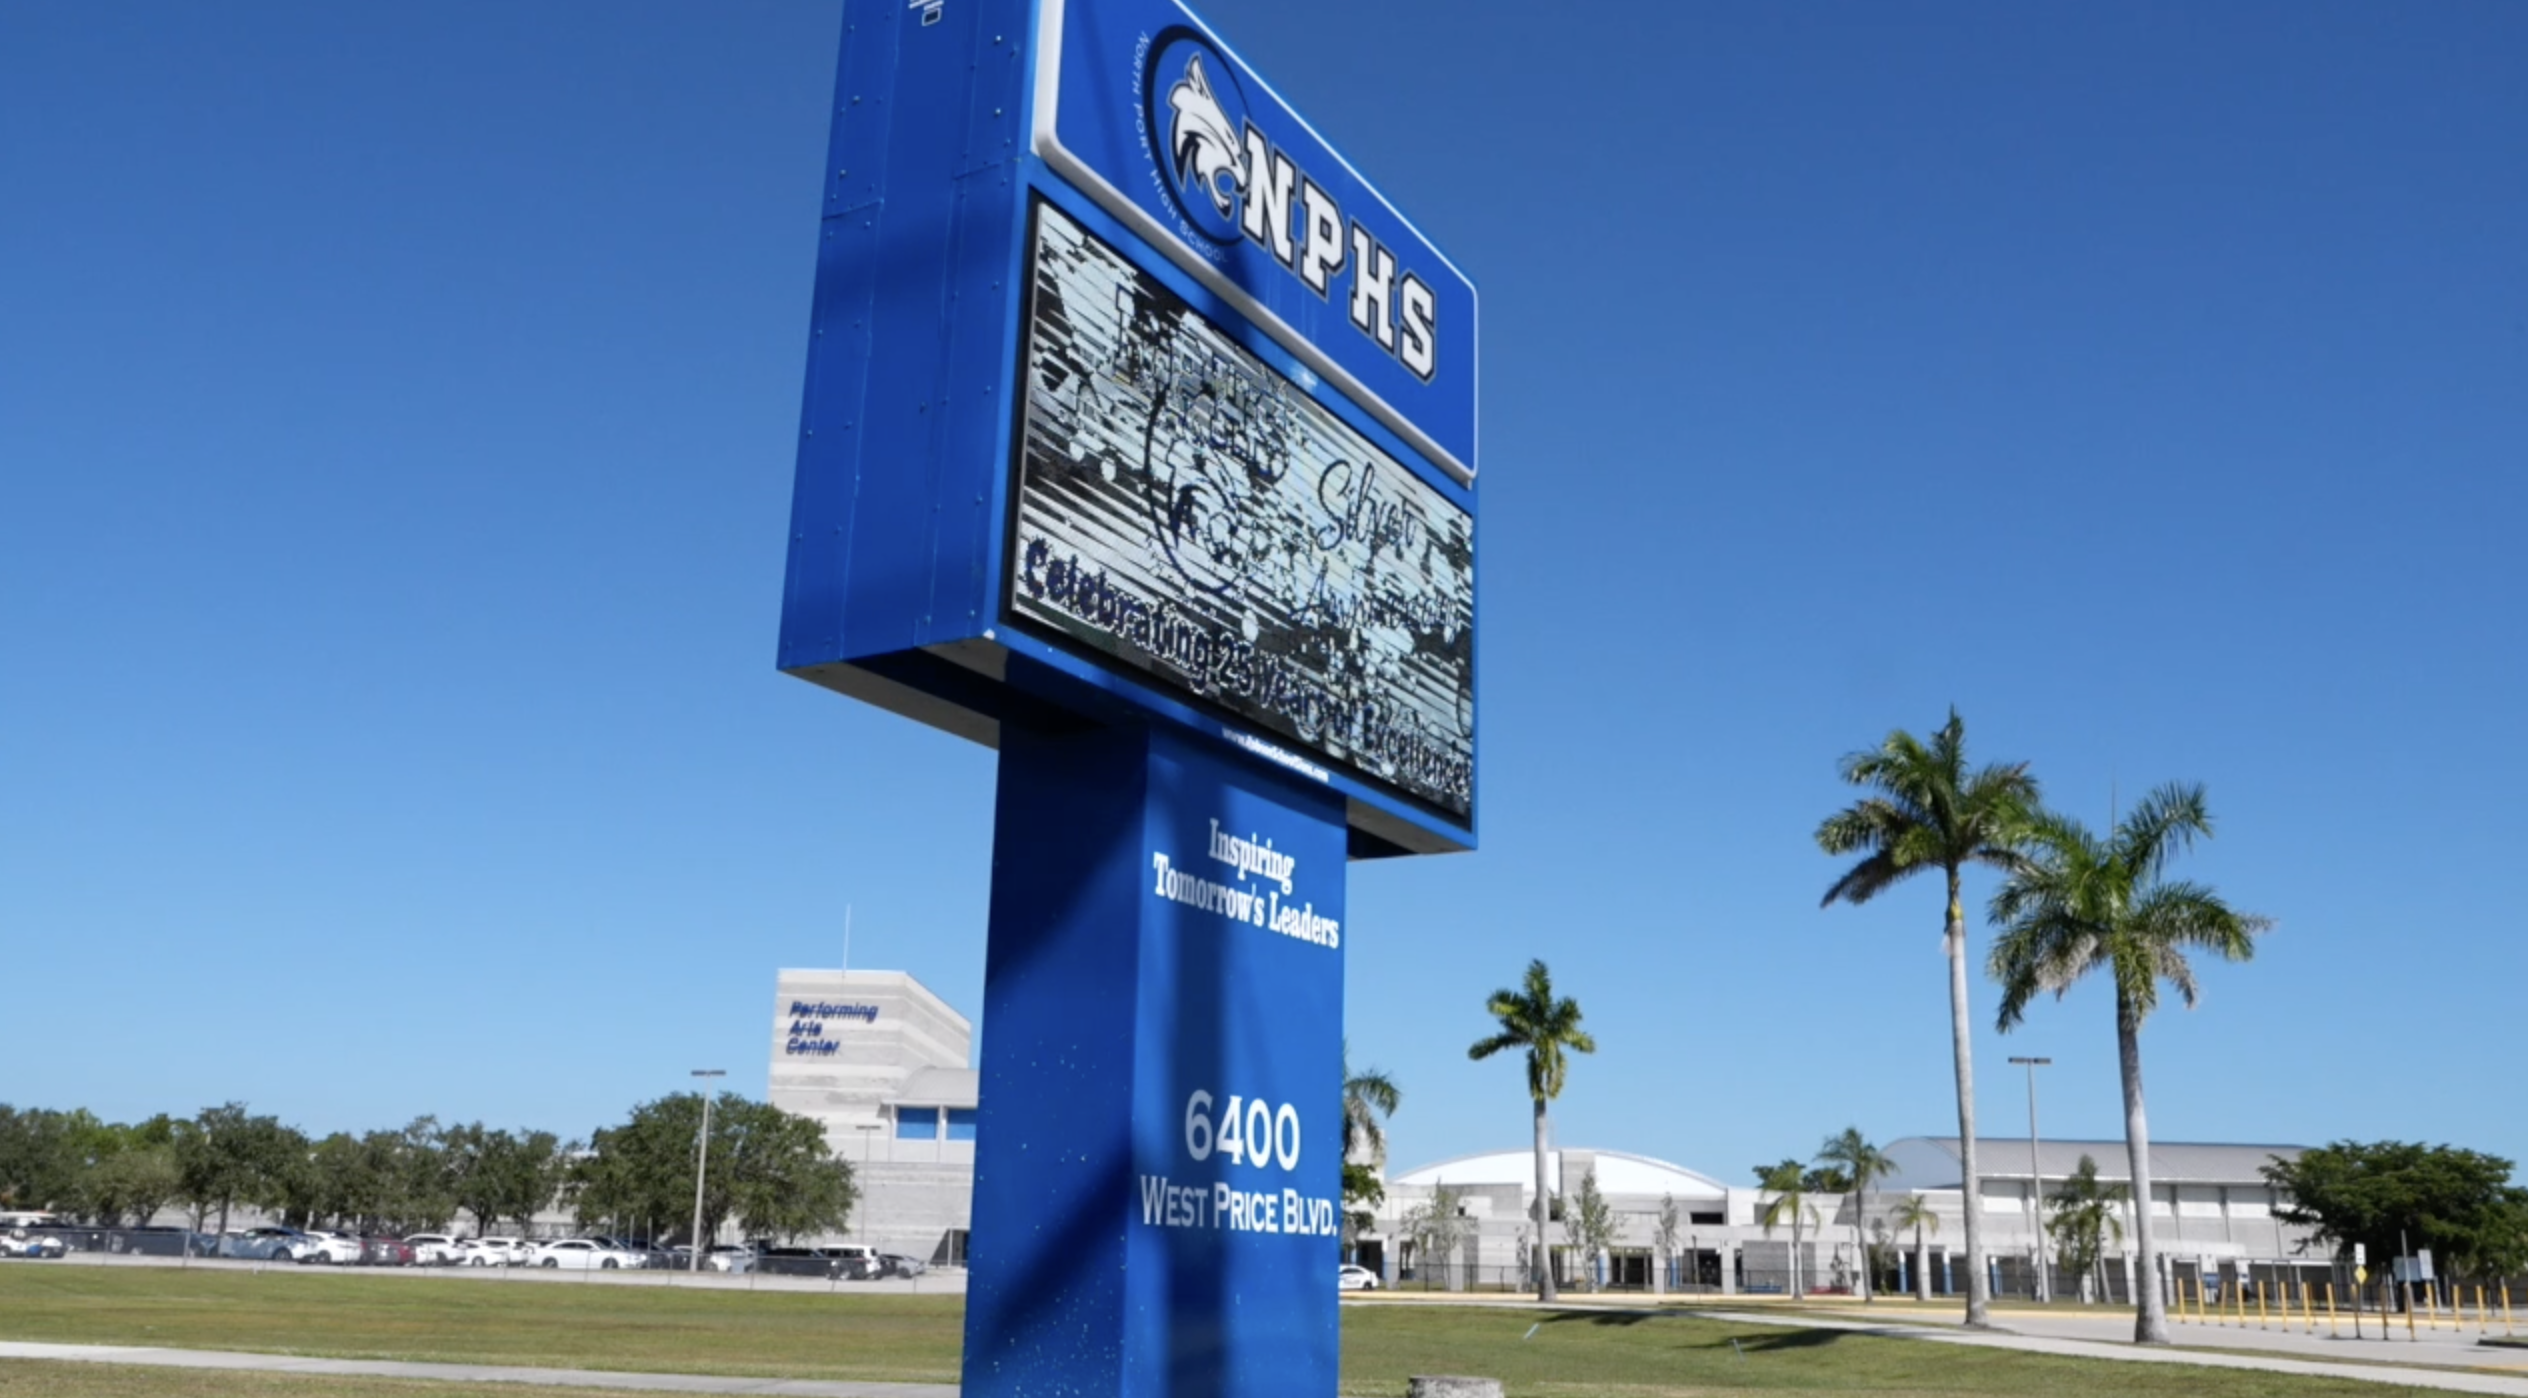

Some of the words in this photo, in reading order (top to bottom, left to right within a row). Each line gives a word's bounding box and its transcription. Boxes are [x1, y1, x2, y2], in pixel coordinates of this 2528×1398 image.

[1132, 31, 1149, 95] NORTH
[1133, 103, 1152, 161] PORT
[1149, 168, 1178, 221] HIGH
[1178, 218, 1229, 263] SCHOOL
[1241, 116, 1436, 385] NPHS
[1317, 458, 1418, 552] Silver
[1025, 537, 1214, 695] Celebrating
[1217, 630, 1256, 697] 25
[1208, 817, 1295, 895] Inspiring
[1153, 851, 1265, 927] Tomorrow's
[1268, 890, 1339, 949] Leaders
[788, 1001, 879, 1024] Performing
[788, 1019, 823, 1037] Arts
[786, 1037, 840, 1056] Center
[1185, 1089, 1300, 1171] 6400
[1140, 1175, 1208, 1227] WEST
[1214, 1181, 1279, 1233] PRICE
[1283, 1188, 1338, 1237] BLVD.
